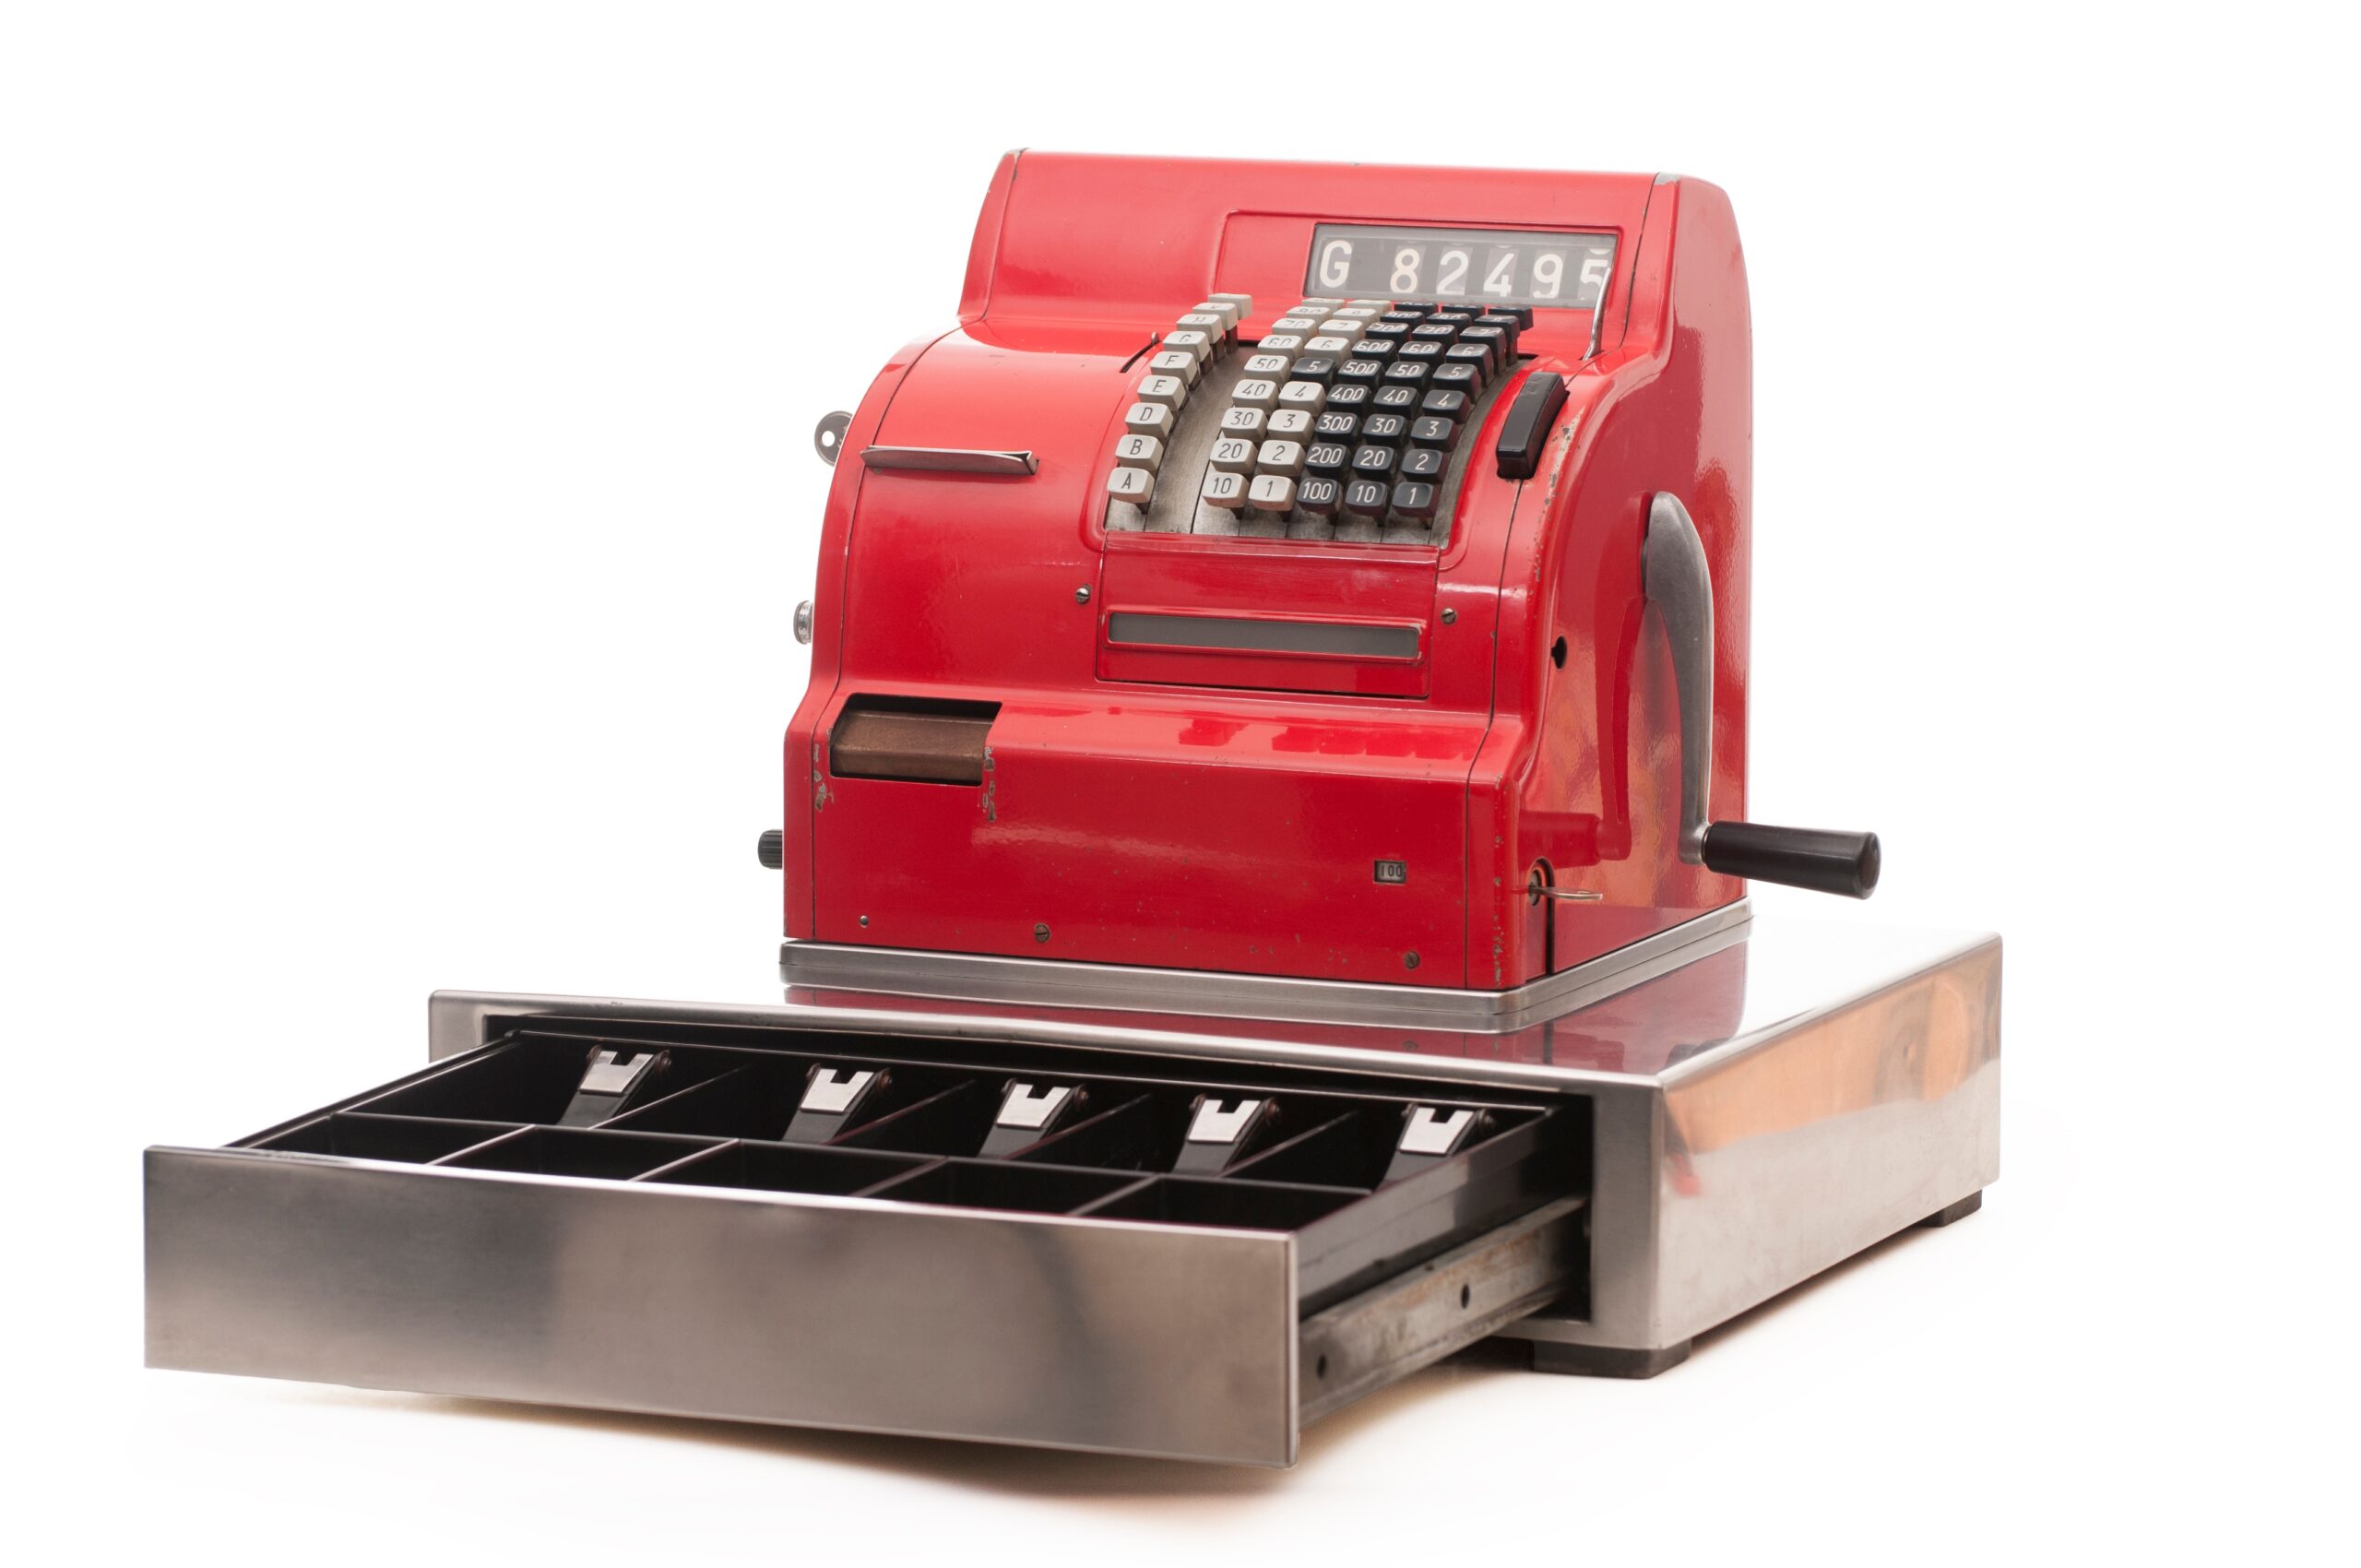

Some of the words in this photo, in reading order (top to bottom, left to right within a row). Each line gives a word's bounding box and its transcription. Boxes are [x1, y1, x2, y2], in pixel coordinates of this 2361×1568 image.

[1319, 240, 1352, 288] G
[1179, 334, 1192, 342] G
[1268, 338, 1293, 347] 60
[1321, 339, 1334, 349] 6
[1356, 341, 1392, 351] 600
[1408, 344, 1433, 353] 60
[1462, 347, 1475, 355] 6
[1165, 355, 1180, 365] F
[1255, 358, 1279, 369] 50
[1305, 361, 1322, 372] 5
[1343, 362, 1377, 374] 500
[1394, 364, 1420, 376] 50
[1448, 366, 1463, 378] 5
[1153, 379, 1167, 393] E
[1242, 383, 1267, 397] 40
[1294, 386, 1307, 398] 4
[1331, 387, 1365, 401] 400
[1383, 389, 1408, 403] 40
[1437, 393, 1450, 408] 4
[1139, 407, 1153, 422] D
[1231, 411, 1254, 426] 30
[1283, 413, 1296, 428] 3
[1319, 415, 1353, 431] 300
[1371, 418, 1396, 434] 30
[1426, 421, 1440, 436] 3
[1130, 439, 1143, 456] B
[1217, 443, 1242, 458] 20
[1272, 445, 1286, 461] 2
[1308, 446, 1343, 464] 200
[1360, 450, 1385, 467] 20
[1415, 453, 1429, 470] 2
[1121, 472, 1133, 490] A
[1214, 477, 1232, 494] 10
[1266, 481, 1275, 497] 1
[1303, 481, 1332, 500] 100
[1356, 485, 1376, 503] 10
[1408, 487, 1417, 505] 1
